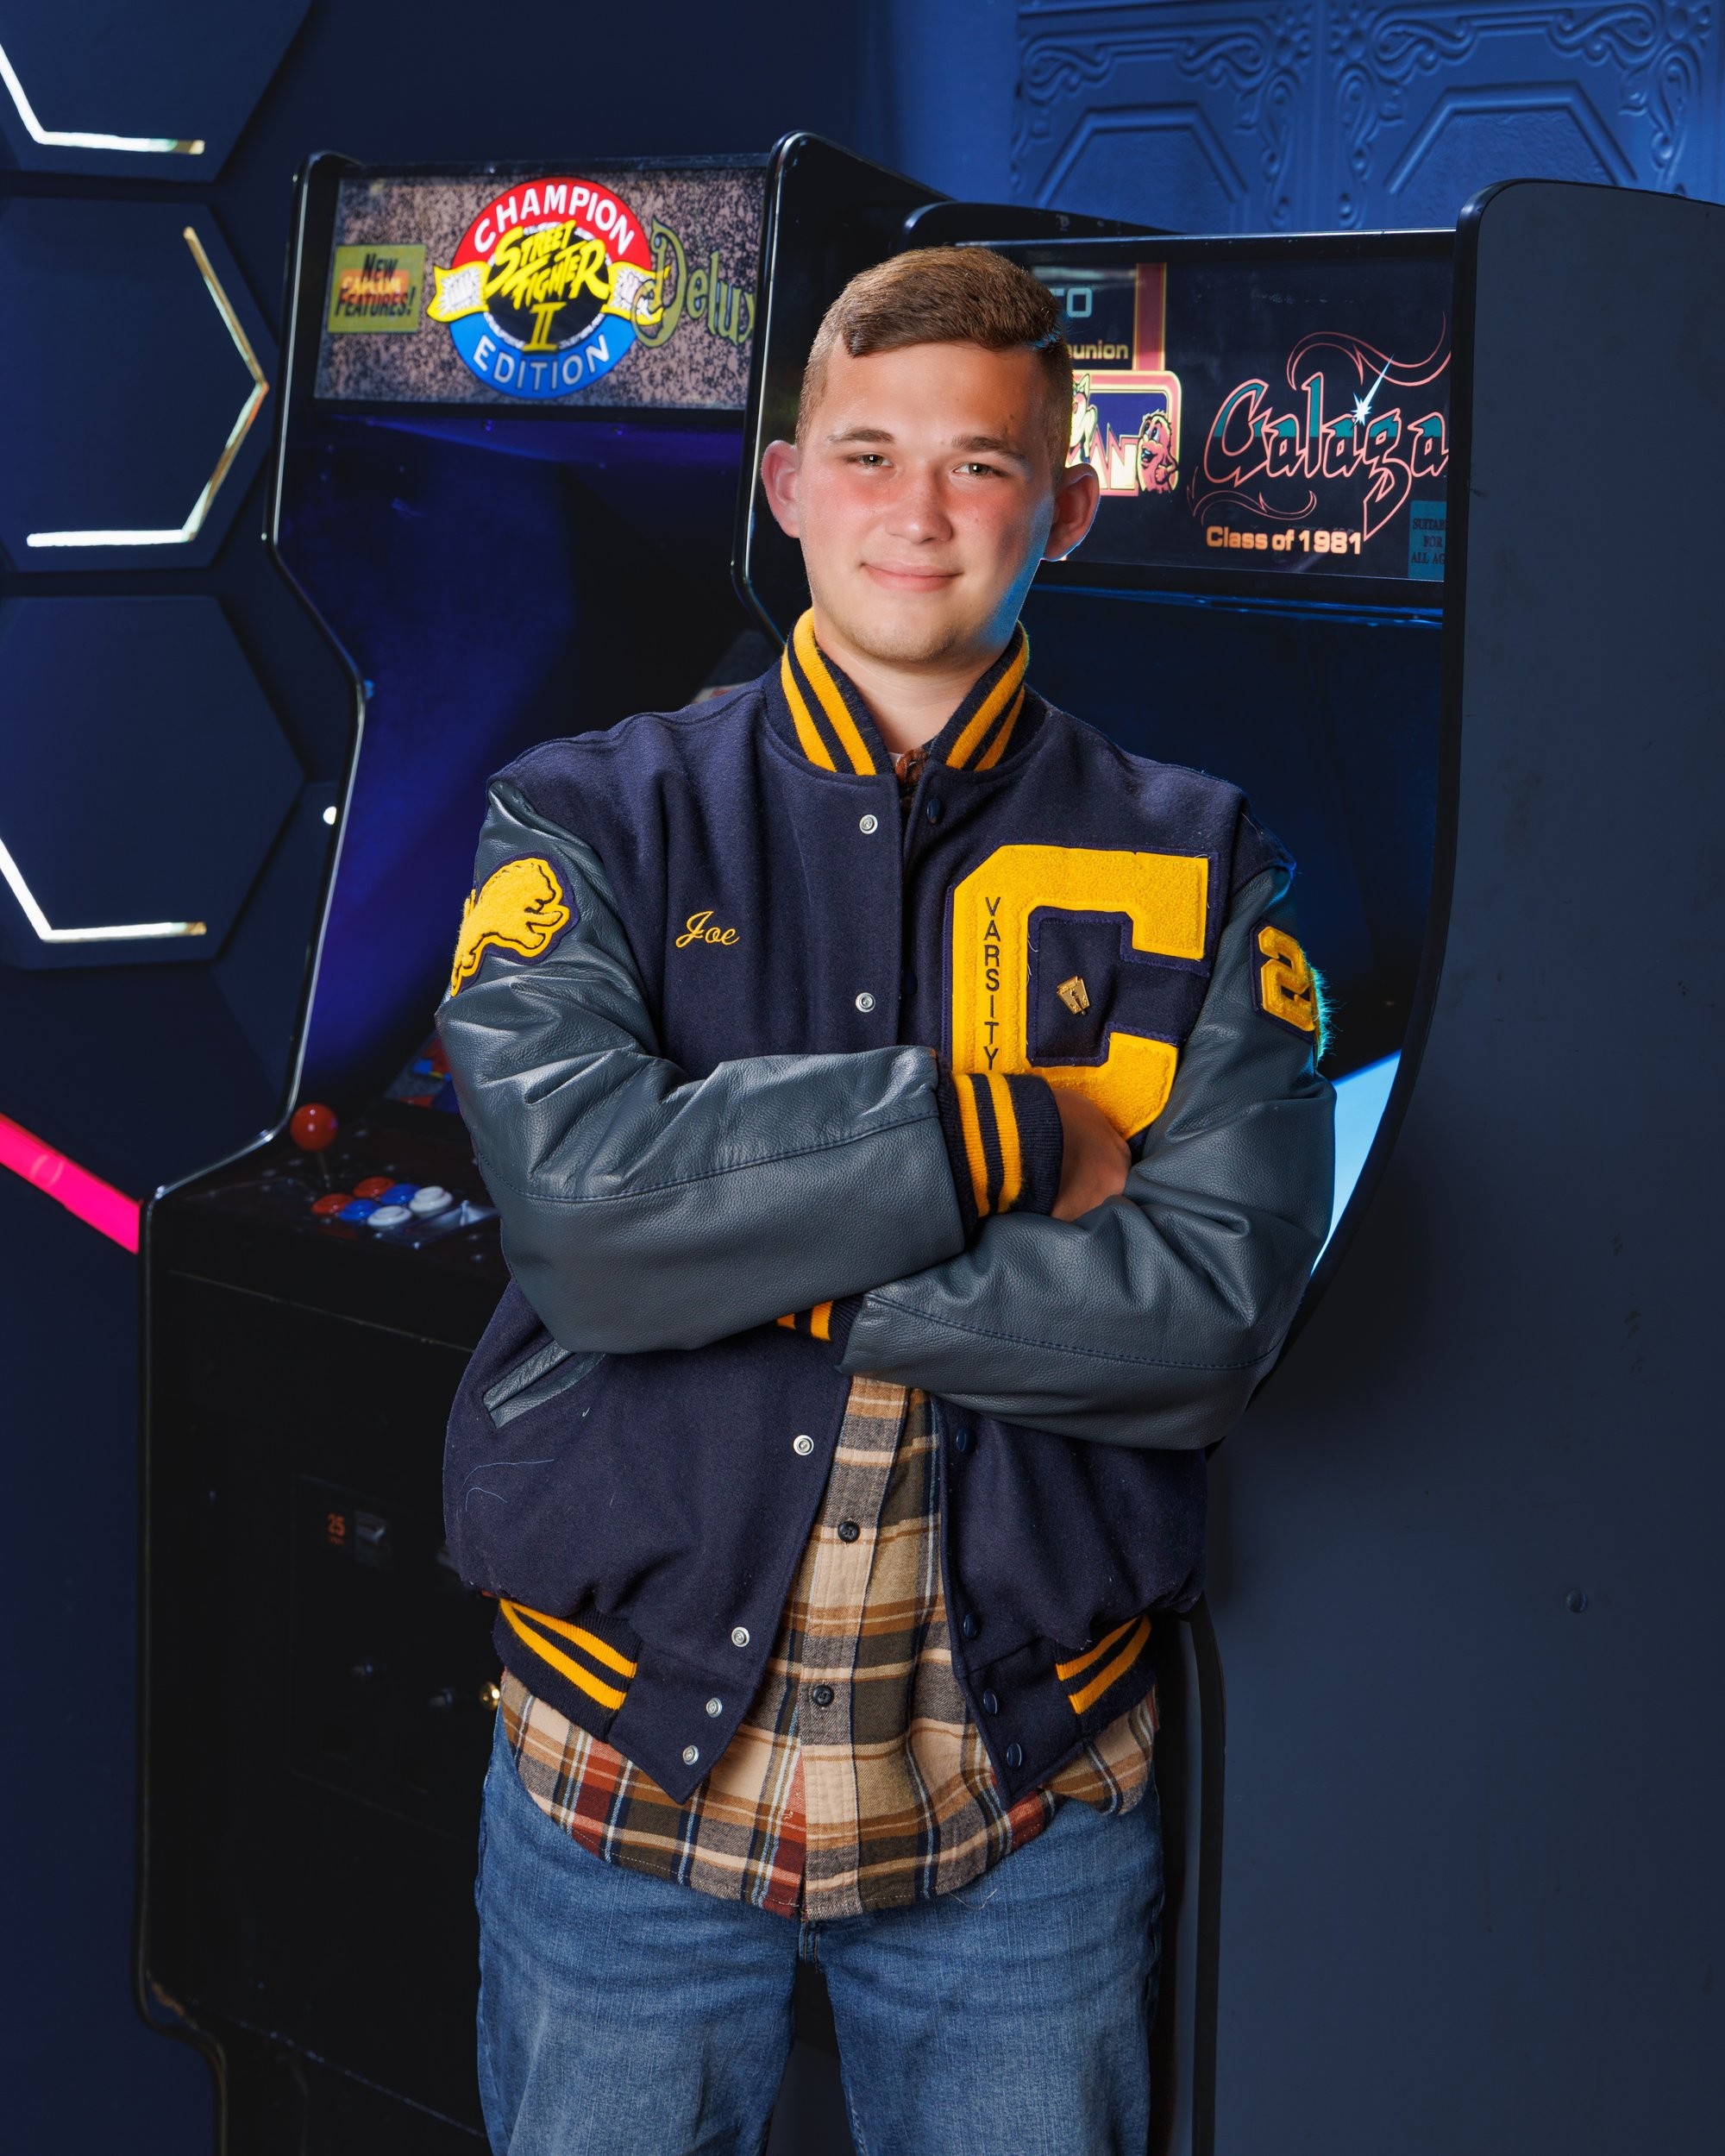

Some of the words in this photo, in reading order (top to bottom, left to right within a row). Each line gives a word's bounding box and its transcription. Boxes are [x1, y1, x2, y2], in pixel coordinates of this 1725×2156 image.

[474, 185, 635, 255] CHAMPION
[361, 254, 398, 283] NEW
[484, 220, 577, 299] STREET
[496, 239, 610, 310] FIGHTER
[335, 286, 416, 317] FEATURES!
[521, 302, 567, 350] II
[474, 334, 609, 390] EDITION
[1204, 372, 1449, 542] Galaga
[1207, 525, 1260, 551] Class
[1264, 529, 1295, 551] of
[1299, 530, 1361, 555] 1981
[1411, 552, 1429, 564] ALL
[1423, 535, 1443, 548] FOR
[675, 910, 740, 948] Joe
[952, 845, 1209, 1142] C
[983, 896, 1003, 1071] VARSITY
[327, 1513, 345, 1537] 25
